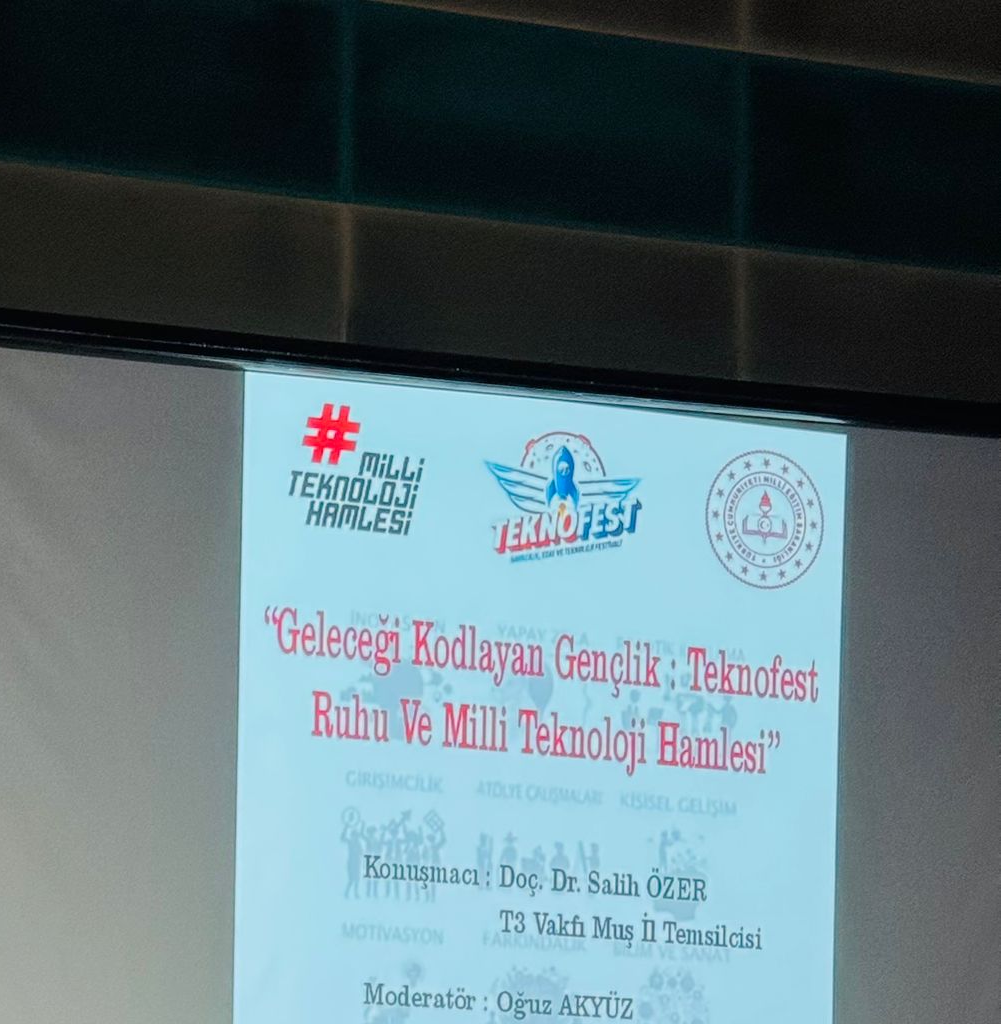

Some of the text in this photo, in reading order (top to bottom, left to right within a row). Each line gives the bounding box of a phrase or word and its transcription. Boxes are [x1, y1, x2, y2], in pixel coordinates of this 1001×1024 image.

[491, 498, 642, 554] TEKNOFEST
[412, 620, 545, 687] Kodlayan
[555, 634, 661, 699] Gençlik
[687, 646, 819, 703] Teknofest
[311, 690, 389, 742] Ruhu
[399, 698, 433, 746] Ve
[442, 702, 508, 752] Milli
[518, 709, 647, 777] Teknoloji
[363, 854, 479, 889] Konuşmacı
[499, 864, 543, 897] Doç.
[551, 868, 581, 893] Dr.
[588, 870, 640, 897] Salih
[647, 867, 708, 902] ÖZER
[499, 909, 526, 934] T3
[592, 916, 634, 948] Muş
[641, 912, 657, 943] İl
[663, 920, 762, 950] Temsilcisi
[363, 982, 476, 1011] Moderatör
[497, 990, 552, 1020] Oğuz
[558, 990, 634, 1021] AKYÜZ
